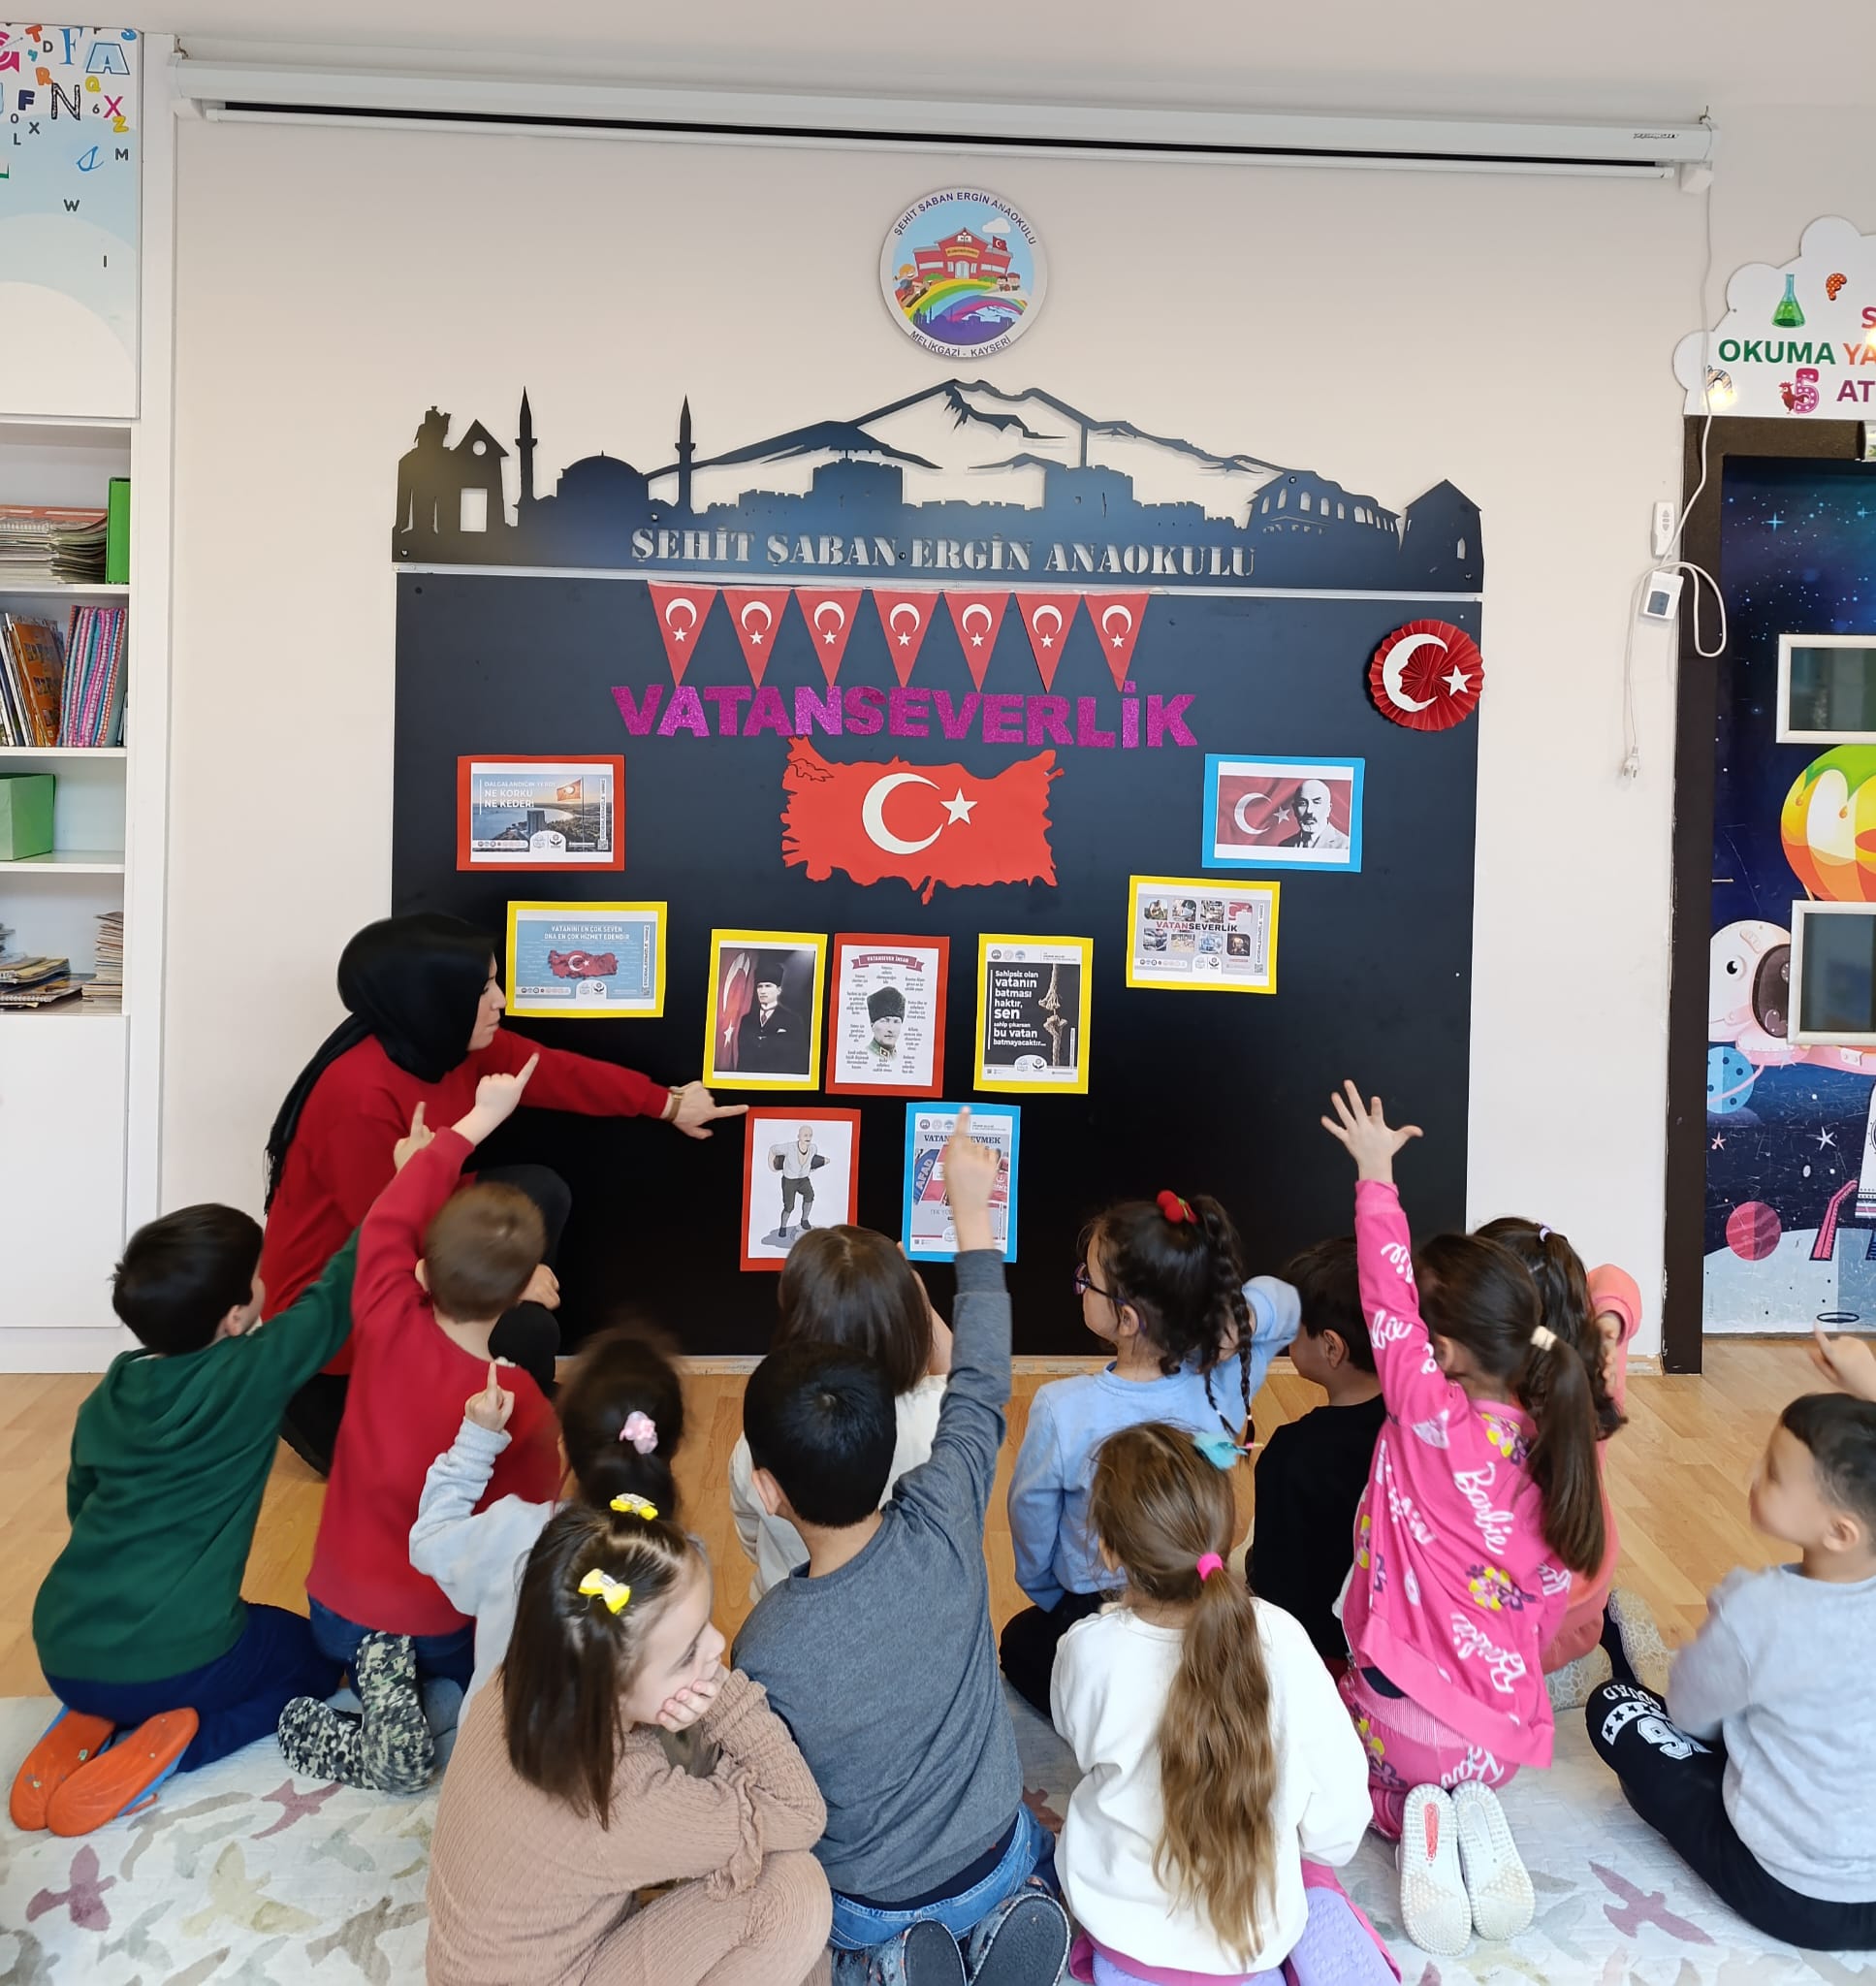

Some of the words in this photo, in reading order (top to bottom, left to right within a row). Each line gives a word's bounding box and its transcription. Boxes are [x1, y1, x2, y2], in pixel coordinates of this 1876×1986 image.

[25, 24, 43, 43] T
[43, 41, 53, 52] D
[59, 26, 84, 65] F
[85, 42, 130, 75] A
[35, 67, 53, 85] R
[84, 76, 101, 92] Q
[17, 89, 35, 111] F
[51, 82, 80, 120] N
[104, 95, 123, 118] X
[92, 104, 100, 113] 6
[112, 115, 129, 133] Z
[14, 133, 21, 145] L
[115, 147, 129, 161] M
[63, 199, 79, 212] W
[894, 208, 917, 237] ŞEHİT
[919, 192, 954, 213] ŞABAN
[956, 191, 990, 205] ERGİN
[991, 199, 1036, 245] ANAOKULU
[910, 330, 961, 358] MELİKGAZİ
[970, 334, 1011, 357] KAYSERİ
[1718, 338, 1836, 366] OKUMA
[631, 527, 755, 561] ŞEHİT
[767, 532, 897, 566] ŞABAN
[909, 533, 1033, 571] ERGİN
[1044, 541, 1256, 577] ANAOKULU
[611, 679, 1198, 749] VATANSEVERLİK
[485, 789, 497, 798] NE
[500, 789, 533, 798] KORKU
[485, 799, 497, 808] NE
[500, 799, 534, 808] KEDER!
[1156, 920, 1238, 932] VATANSEVERLİK
[995, 970, 1023, 978] Sahipsiz
[995, 977, 1037, 988] vatanın
[995, 988, 1032, 998] batması
[994, 998, 1023, 1009] haktır,
[994, 1009, 1020, 1019] sen
[993, 1028, 1007, 1038] bu
[1009, 1029, 1038, 1039] vatan
[1453, 1461, 1514, 1555] Barbie
